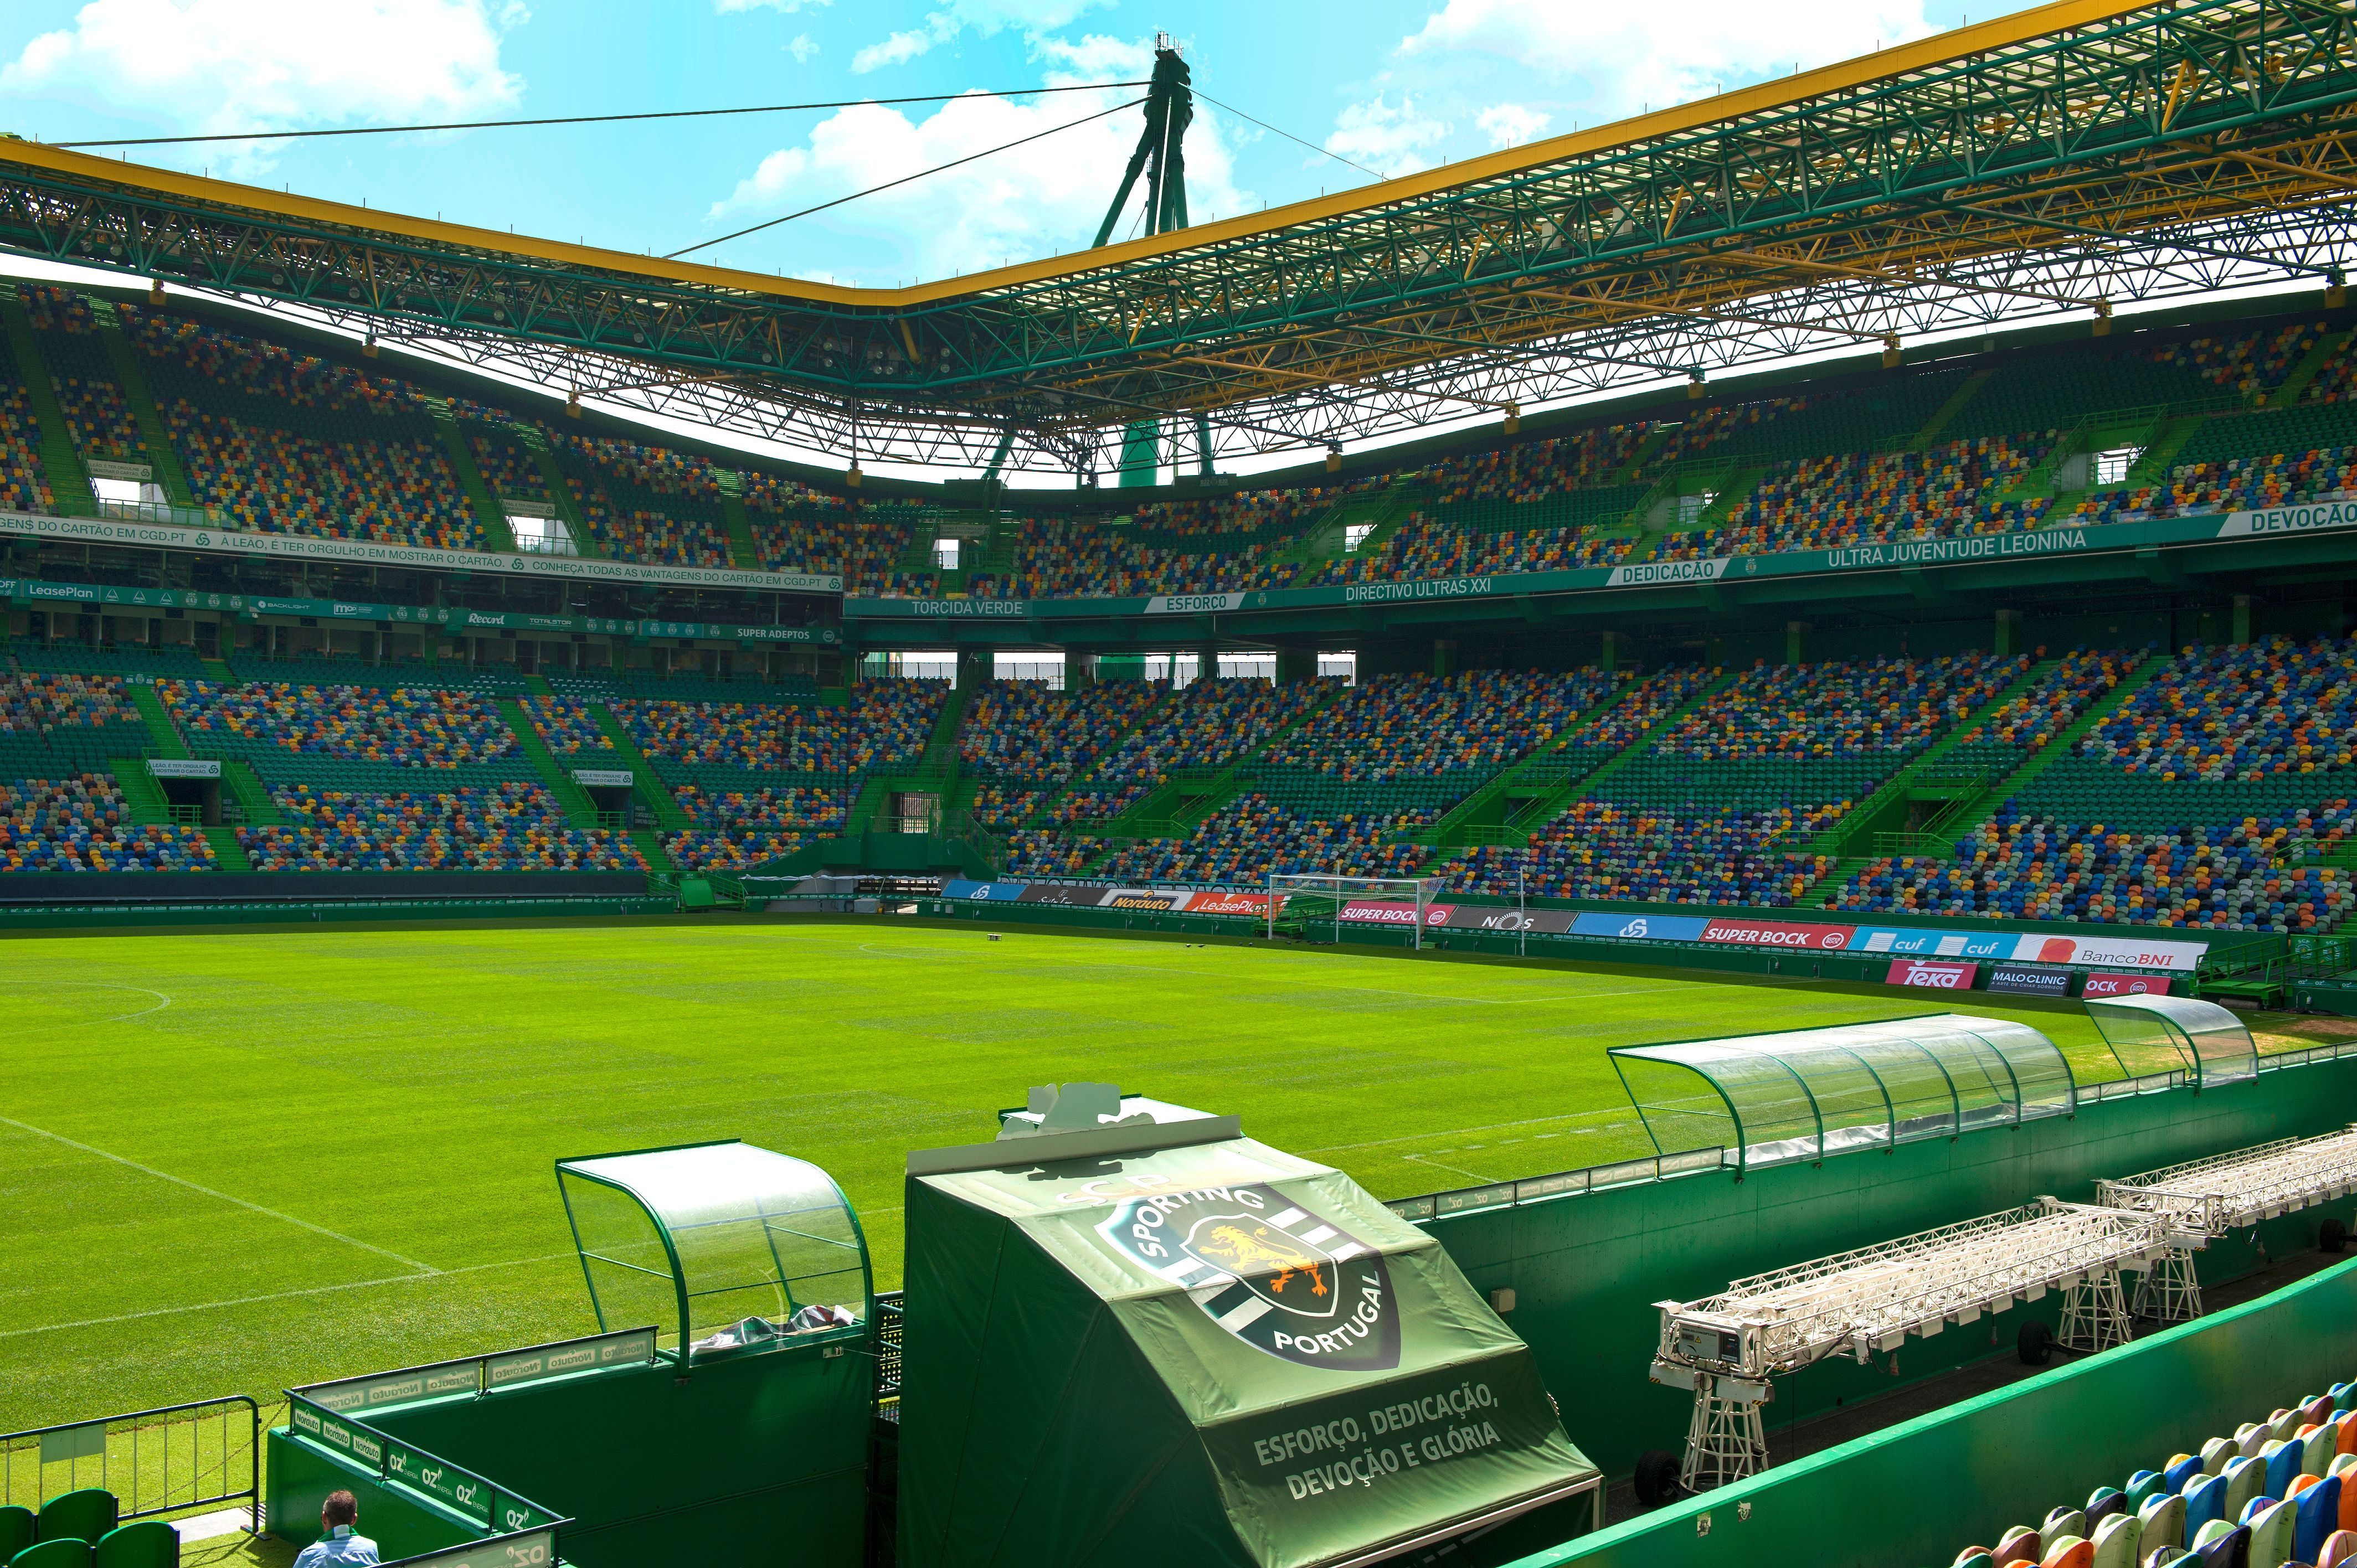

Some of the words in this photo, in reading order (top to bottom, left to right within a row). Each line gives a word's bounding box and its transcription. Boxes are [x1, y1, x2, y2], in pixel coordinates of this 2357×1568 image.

[38, 520, 57, 532] DO
[61, 523, 113, 537] CARTÃO
[117, 528, 135, 538] EM
[140, 530, 187, 543] CGD.PT
[221, 535, 229, 545] À
[233, 537, 267, 550] LEÃO,
[272, 538, 279, 549] É
[282, 541, 305, 551] TER
[308, 544, 365, 557] ORGULHO
[369, 549, 385, 558] EM
[389, 550, 444, 563] MOSTRAR
[447, 555, 455, 564] O
[459, 555, 505, 568] CARTÃO.
[1828, 549, 1883, 568] ULTRA
[1887, 538, 1995, 563] JUVENTUDE
[2000, 530, 2086, 550] LEONINA
[533, 561, 584, 575] CONHEÇA
[588, 566, 621, 576] TODAS
[624, 569, 638, 577] AS
[642, 570, 702, 581] VANTAGENS
[705, 572, 719, 582] DO
[722, 573, 763, 584] CARTÃO
[766, 576, 781, 585] EM
[784, 577, 821, 587] CGD.PT
[1623, 561, 1715, 584] DEDICAÇÃO
[30, 585, 93, 599] LeasePlan
[1346, 582, 1412, 601] DIRECTIVO
[1416, 579, 1467, 598] ULTRAS
[1470, 577, 1490, 593] XXI
[912, 601, 972, 615] TORCIDA
[975, 602, 1023, 615] VERDE
[1167, 595, 1227, 611] ESFORÇO
[469, 613, 505, 625] Record
[738, 628, 766, 638] SUPER
[769, 630, 810, 639] ADEPTOS
[1111, 897, 1171, 910] Norauto
[1342, 908, 1384, 919] SUPER
[1385, 910, 1418, 921] BOCK
[1705, 927, 1756, 941] SUPER
[1759, 930, 1811, 945] BOCK
[1895, 938, 1926, 950] cuf
[1967, 942, 1999, 955] cuf
[2086, 981, 2118, 992] OCK
[1132, 1184, 1265, 1258] SPORTING
[1273, 1271, 1382, 1356] PORTUGAL
[296, 1411, 319, 1431] Norauto
[1254, 1416, 1367, 1468] ESFORÇO,
[1369, 1381, 1499, 1436] DEDICAÇÃO,
[325, 1425, 349, 1445] Norauto
[354, 1439, 379, 1459] Norauto
[1286, 1446, 1399, 1501] DEVOÇÃO
[1402, 1443, 1421, 1468] E
[1422, 1420, 1502, 1460] GLÓRIA
